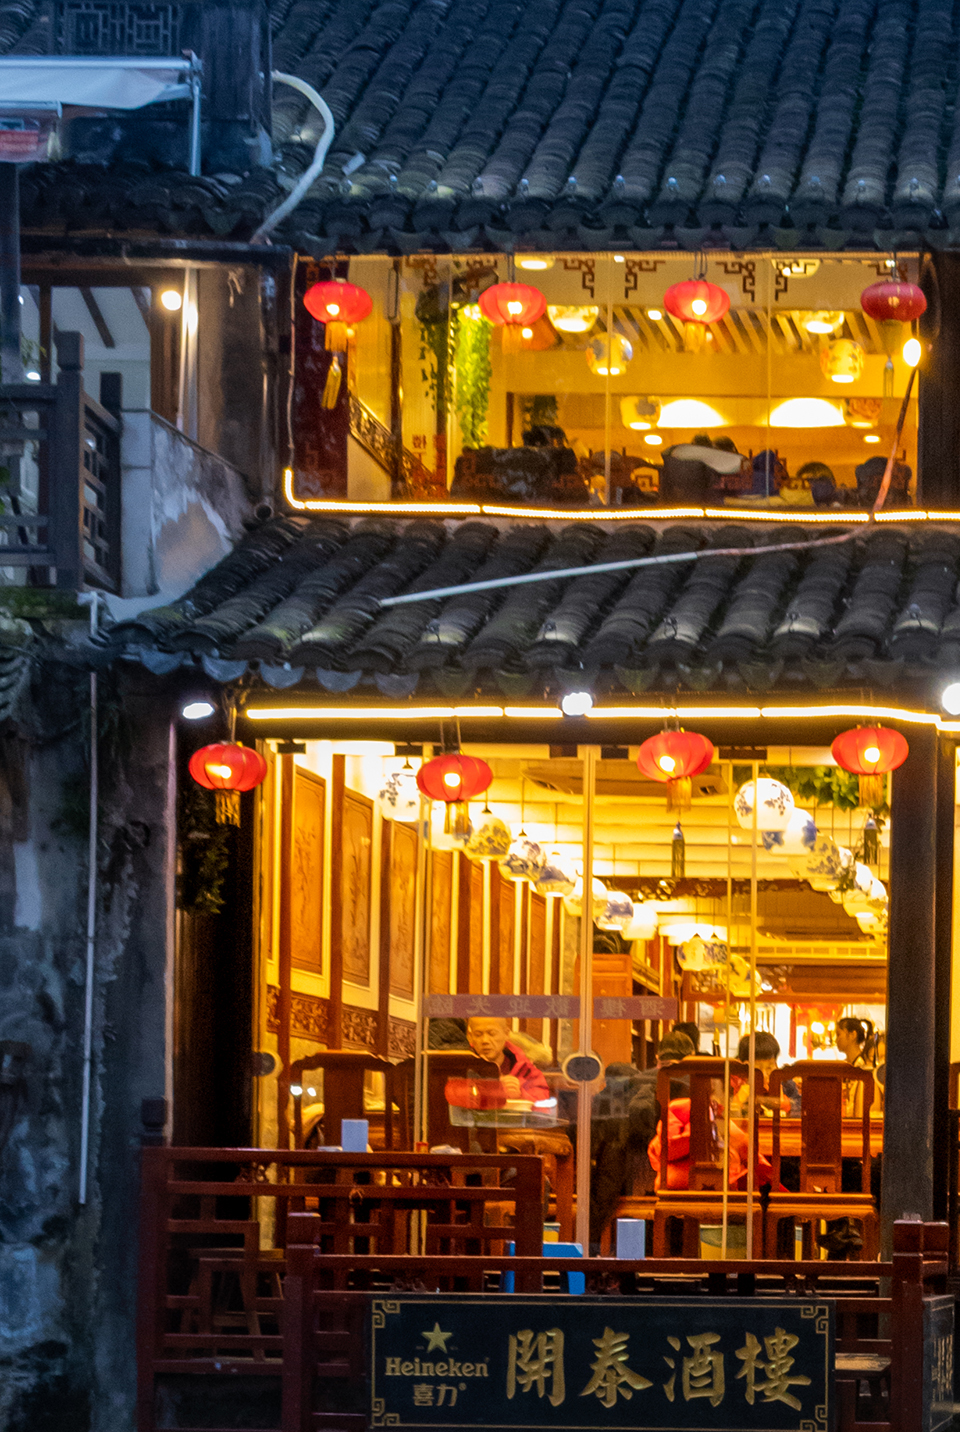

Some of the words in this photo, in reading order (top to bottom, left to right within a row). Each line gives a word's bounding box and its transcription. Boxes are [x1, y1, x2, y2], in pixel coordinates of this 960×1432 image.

[384, 1357, 489, 1377] Heineken
[505, 1326, 812, 1411] 開泰酒樓
